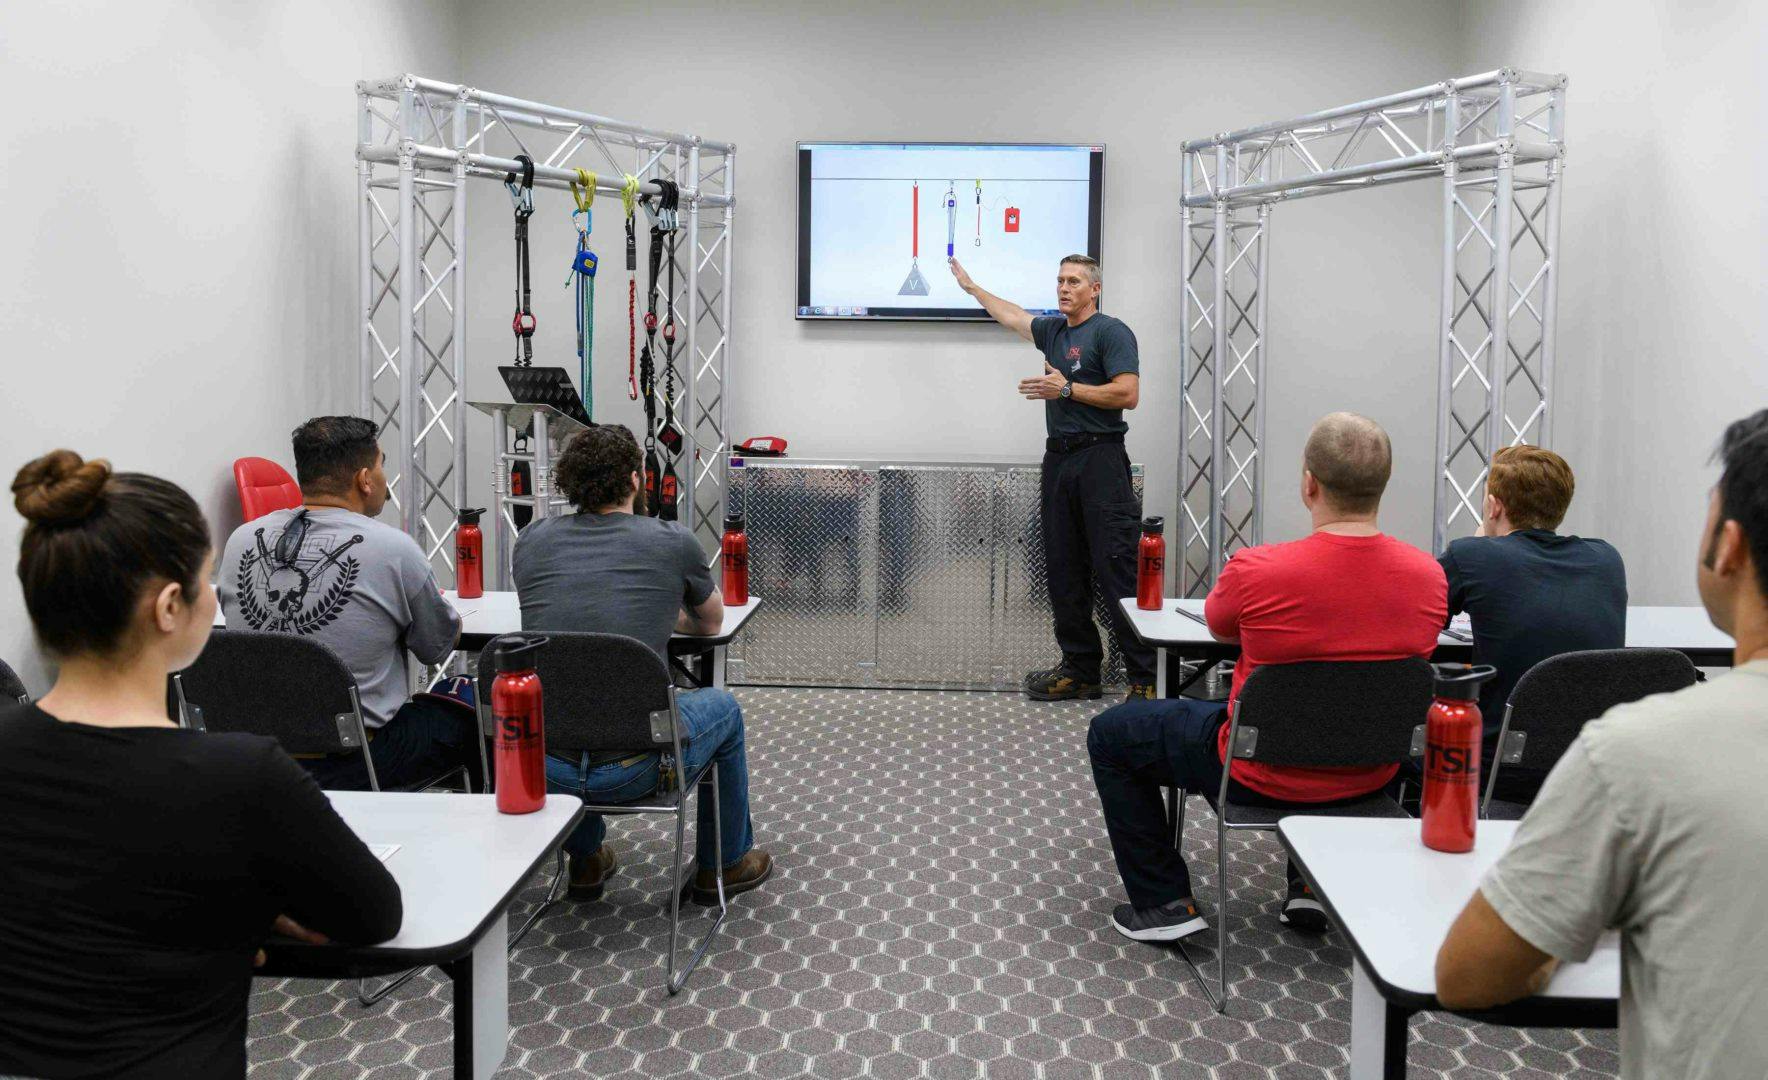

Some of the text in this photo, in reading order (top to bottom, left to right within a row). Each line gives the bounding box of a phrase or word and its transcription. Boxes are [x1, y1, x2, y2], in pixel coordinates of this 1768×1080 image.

[456, 545, 476, 561] SL
[448, 676, 470, 695] T
[1427, 742, 1478, 775] TSL
